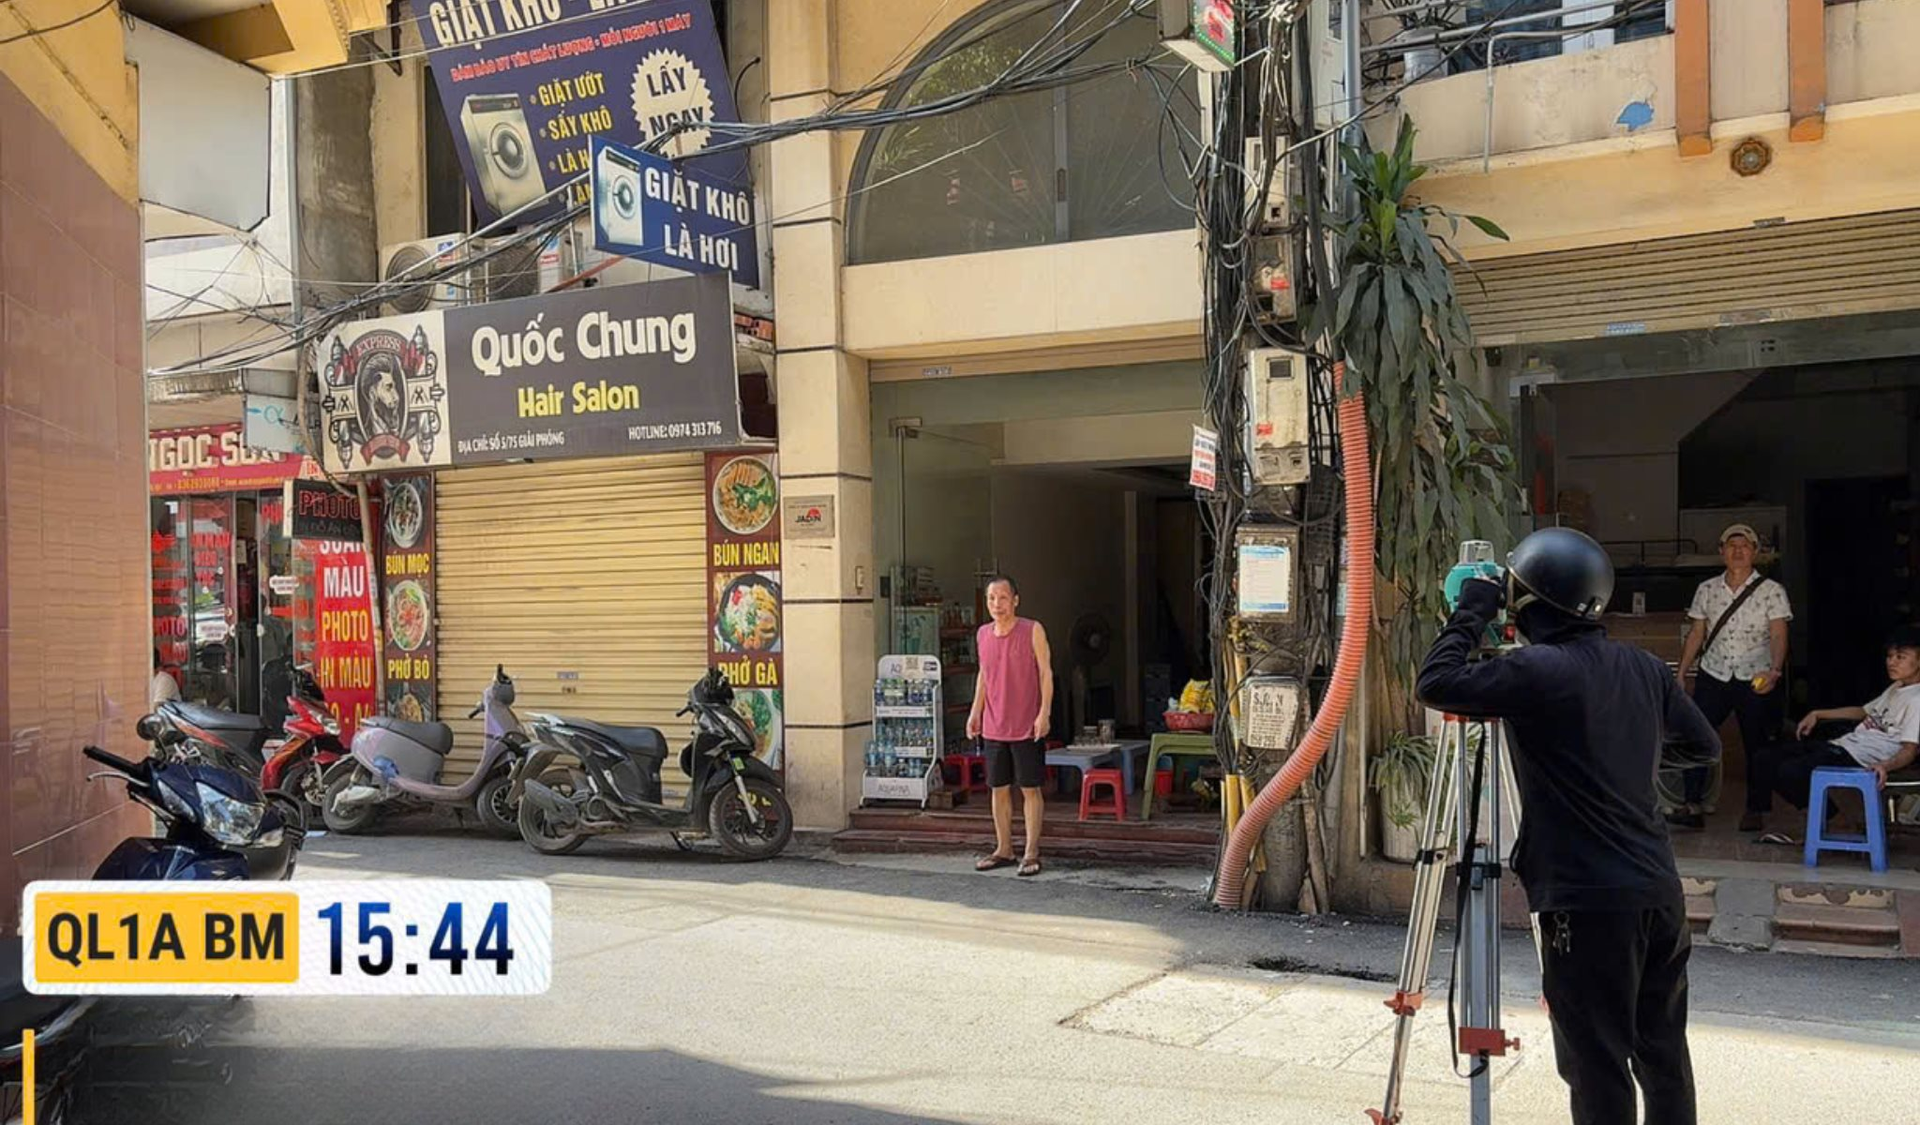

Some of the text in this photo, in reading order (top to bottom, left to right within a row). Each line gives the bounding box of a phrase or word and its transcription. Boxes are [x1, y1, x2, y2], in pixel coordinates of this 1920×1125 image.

[538, 71, 605, 107] GIẶT ƯỚT
[646, 61, 686, 98] LẤY
[548, 105, 612, 140] SẤY KHÔ
[649, 106, 704, 136] NGAY
[557, 148, 578, 174] LÀ
[645, 167, 750, 226] GIẶT KHÔ
[664, 222, 739, 271] LÀ HƠI
[356, 335, 401, 356] EXPRESS
[471, 311, 696, 377] Quốc Chung
[518, 380, 640, 418] Hair Salon
[628, 425, 668, 440] HOTLINE:
[668, 423, 691, 438] 0974
[691, 421, 706, 436] 313
[299, 490, 361, 520] PHOTO
[385, 550, 429, 579] BÚN MỌC
[713, 538, 780, 567] BÚN NGAN
[324, 559, 364, 598] MÀU
[322, 611, 368, 642] PHOTO
[321, 651, 371, 690] IN MÀU
[388, 653, 429, 680] PHỞ BÒ
[718, 655, 778, 686] PHỞ GÀ
